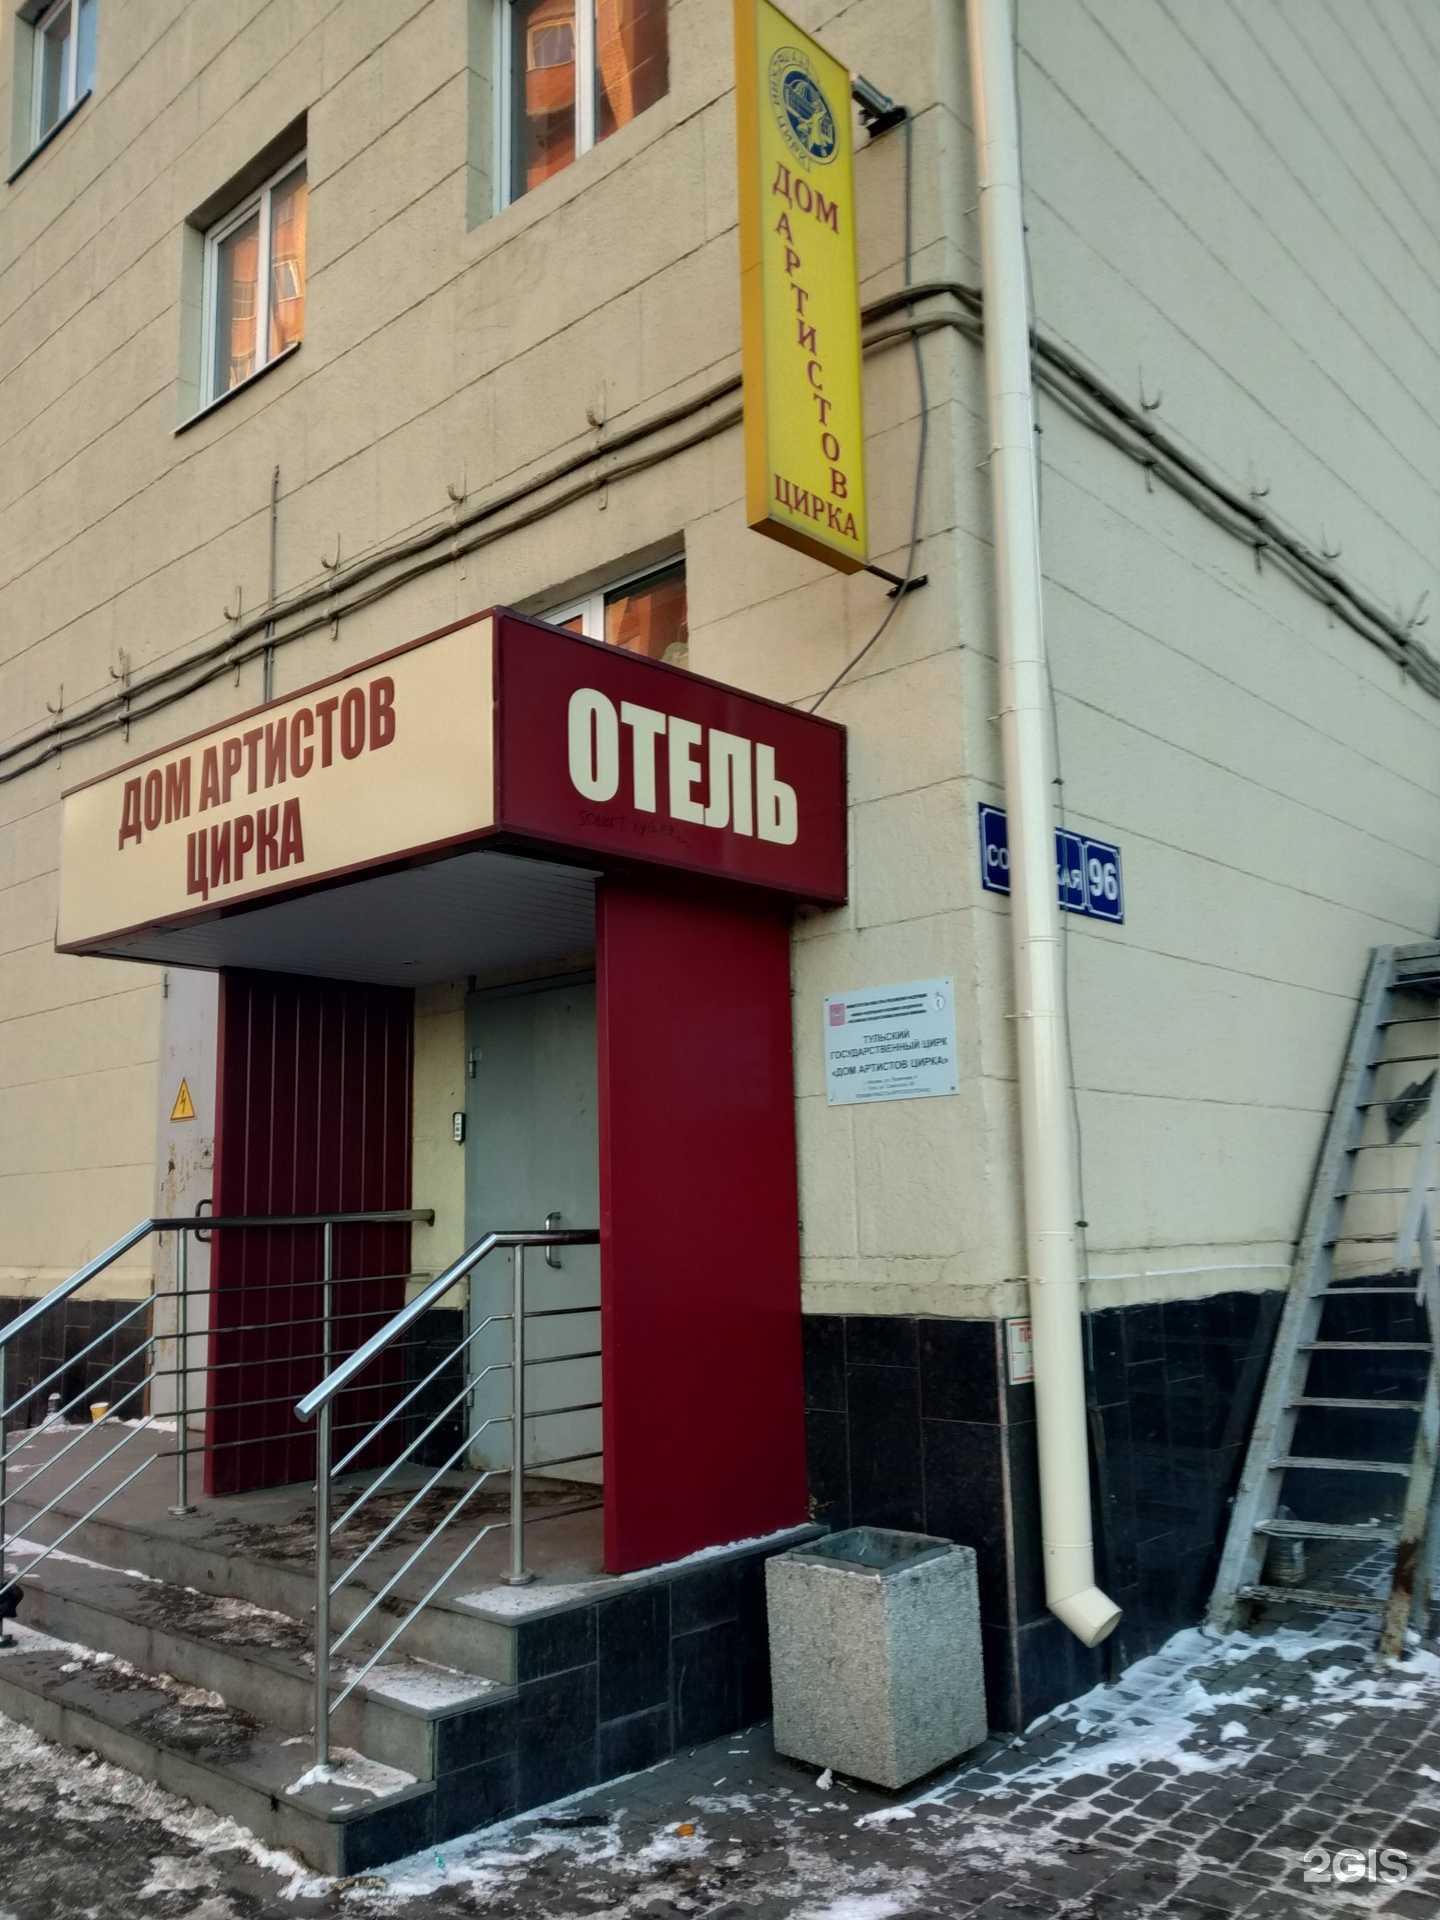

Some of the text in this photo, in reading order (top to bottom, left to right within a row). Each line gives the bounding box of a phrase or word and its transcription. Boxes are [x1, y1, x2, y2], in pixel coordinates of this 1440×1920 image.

[772, 161, 839, 235] ДОМ
[775, 211, 848, 500] АРТИСТОВ
[774, 473, 859, 541] ЦИРКА
[118, 676, 396, 851] ДОМ АРТИСТОВ
[568, 687, 798, 846] ОТЕЛЬ
[187, 796, 305, 901] ЦИРКА
[1088, 857, 1119, 901] 96
[830, 1037, 949, 1060] ГОСУДАРСТВЕННЫЙ ЦИРК
[858, 1059, 909, 1074] АРТИСТОВ
[863, 1028, 911, 1044] ТУЛЬСКИЙ
